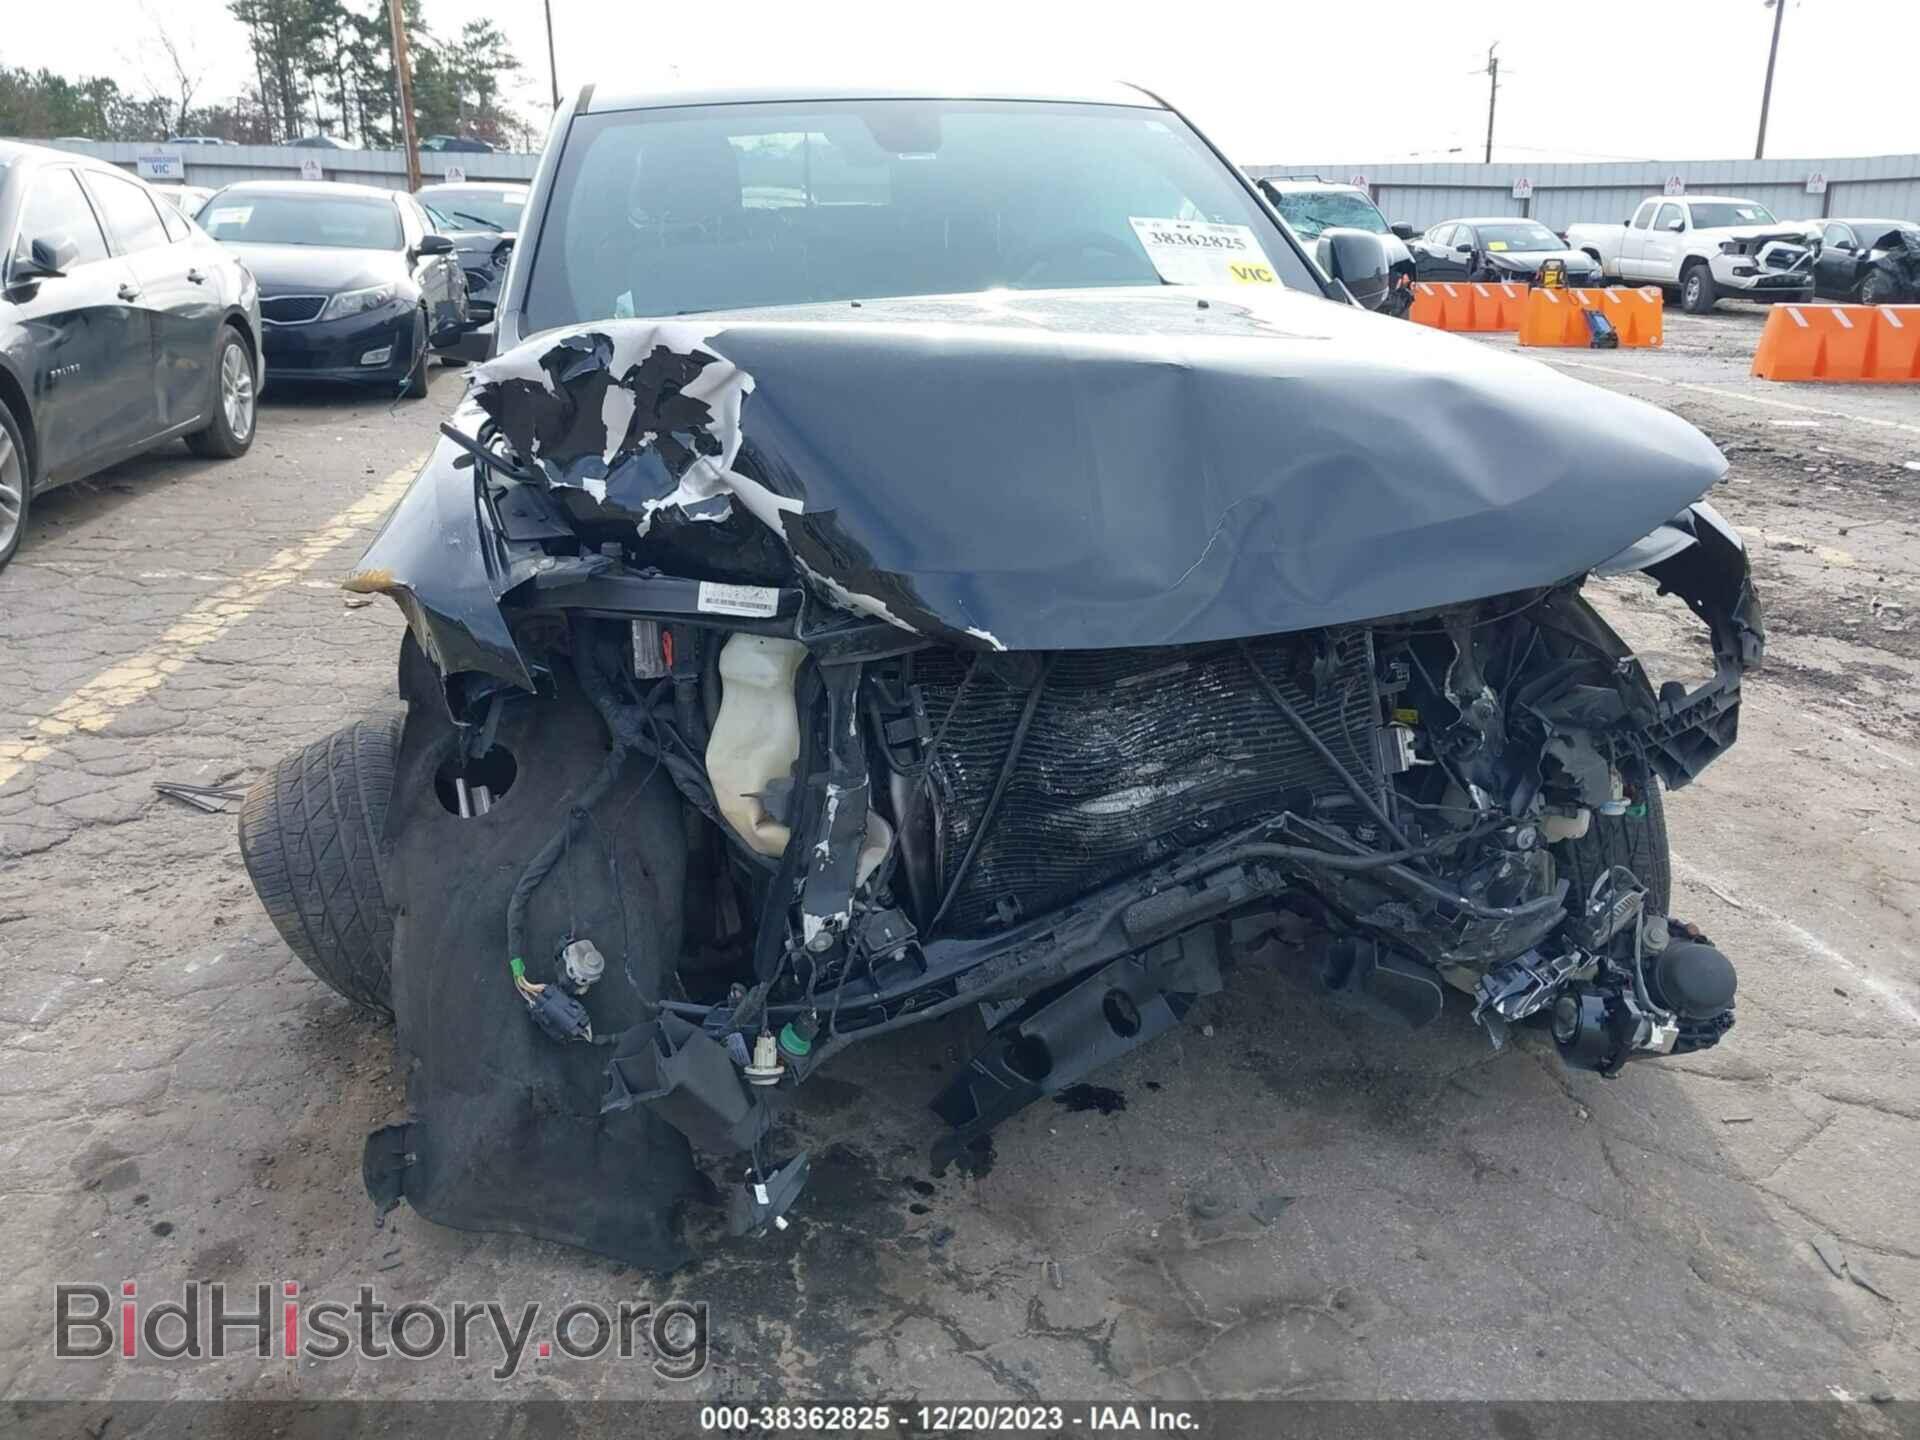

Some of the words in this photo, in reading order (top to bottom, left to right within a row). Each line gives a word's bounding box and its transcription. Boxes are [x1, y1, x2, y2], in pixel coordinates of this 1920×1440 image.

[152, 164, 169, 174] VIC
[1149, 231, 1247, 250] 38362825
[1230, 265, 1273, 283] VIC
